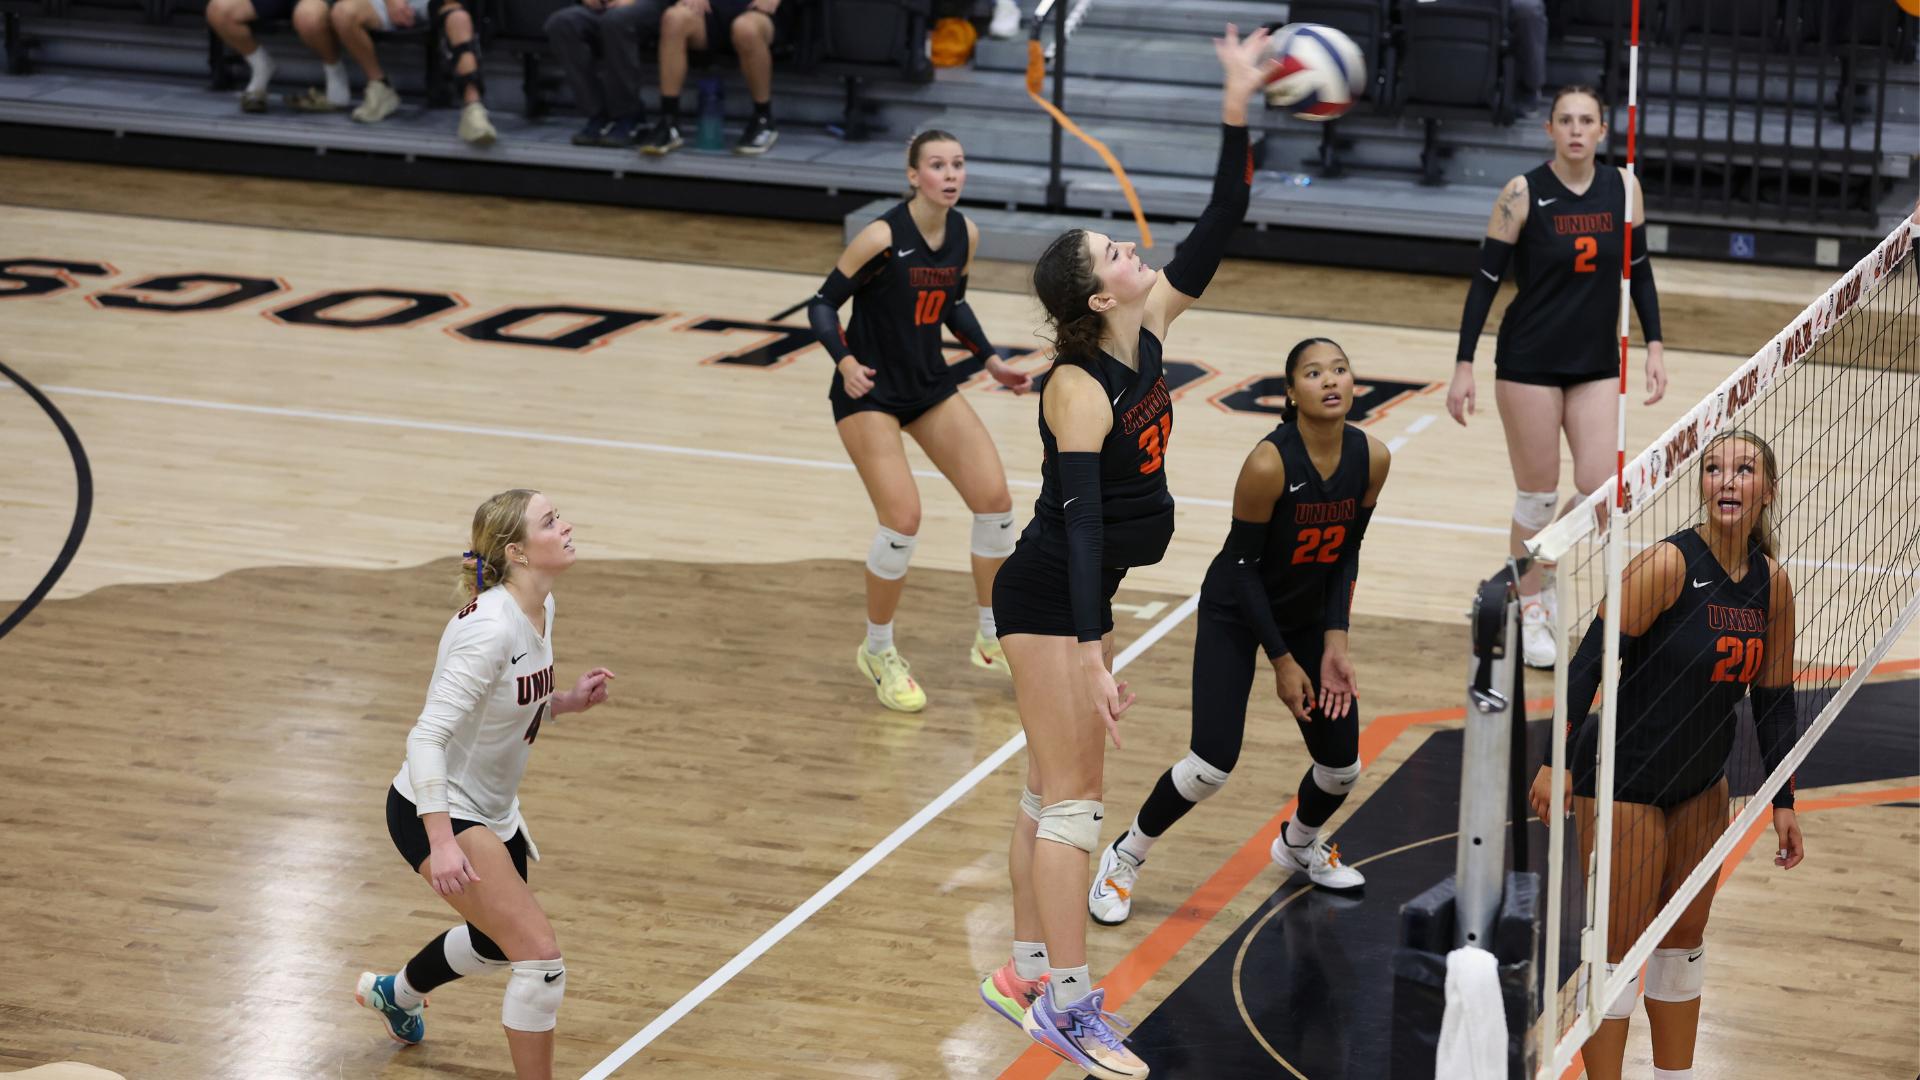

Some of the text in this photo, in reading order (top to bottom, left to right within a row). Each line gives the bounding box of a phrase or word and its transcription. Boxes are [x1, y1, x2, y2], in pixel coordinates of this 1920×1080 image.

[1553, 212, 1613, 235] UNION
[1574, 236, 1598, 272] 2
[908, 266, 958, 287] UNION
[915, 290, 946, 326] 10
[1121, 376, 1171, 435] UNION
[1139, 412, 1171, 474] 31
[1295, 498, 1355, 524] UNION
[1291, 525, 1346, 565] 22
[1707, 604, 1766, 633] UNION
[1710, 636, 1764, 683] 20
